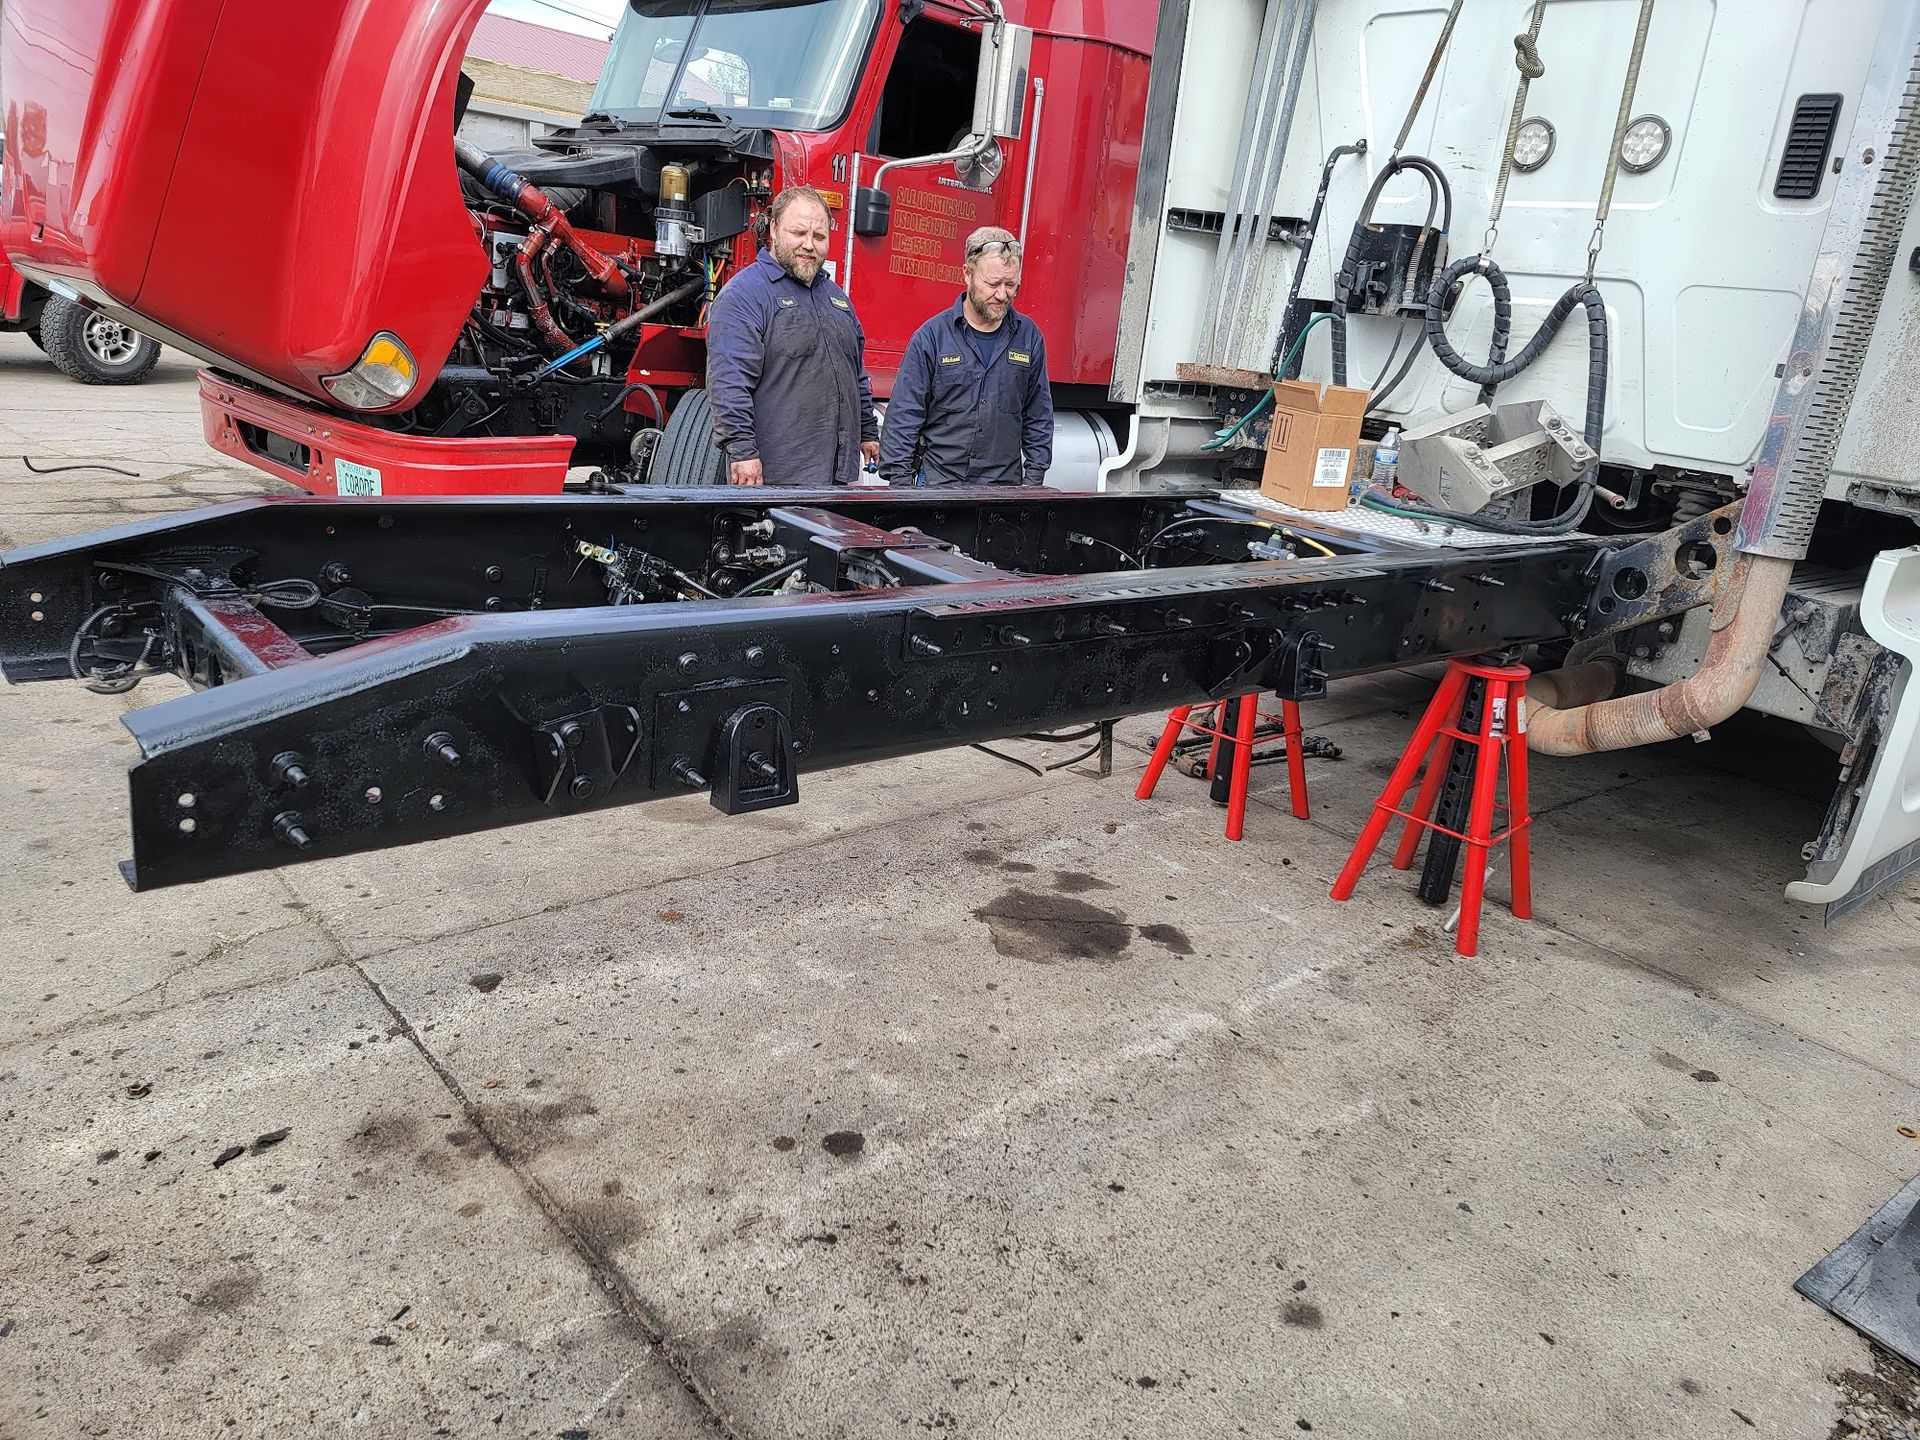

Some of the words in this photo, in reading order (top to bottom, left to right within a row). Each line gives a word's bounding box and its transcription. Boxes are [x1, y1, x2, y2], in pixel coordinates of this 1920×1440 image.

[831, 153, 847, 184] 11
[917, 191, 958, 218] LOGISTICS
[947, 265, 967, 286] 302
